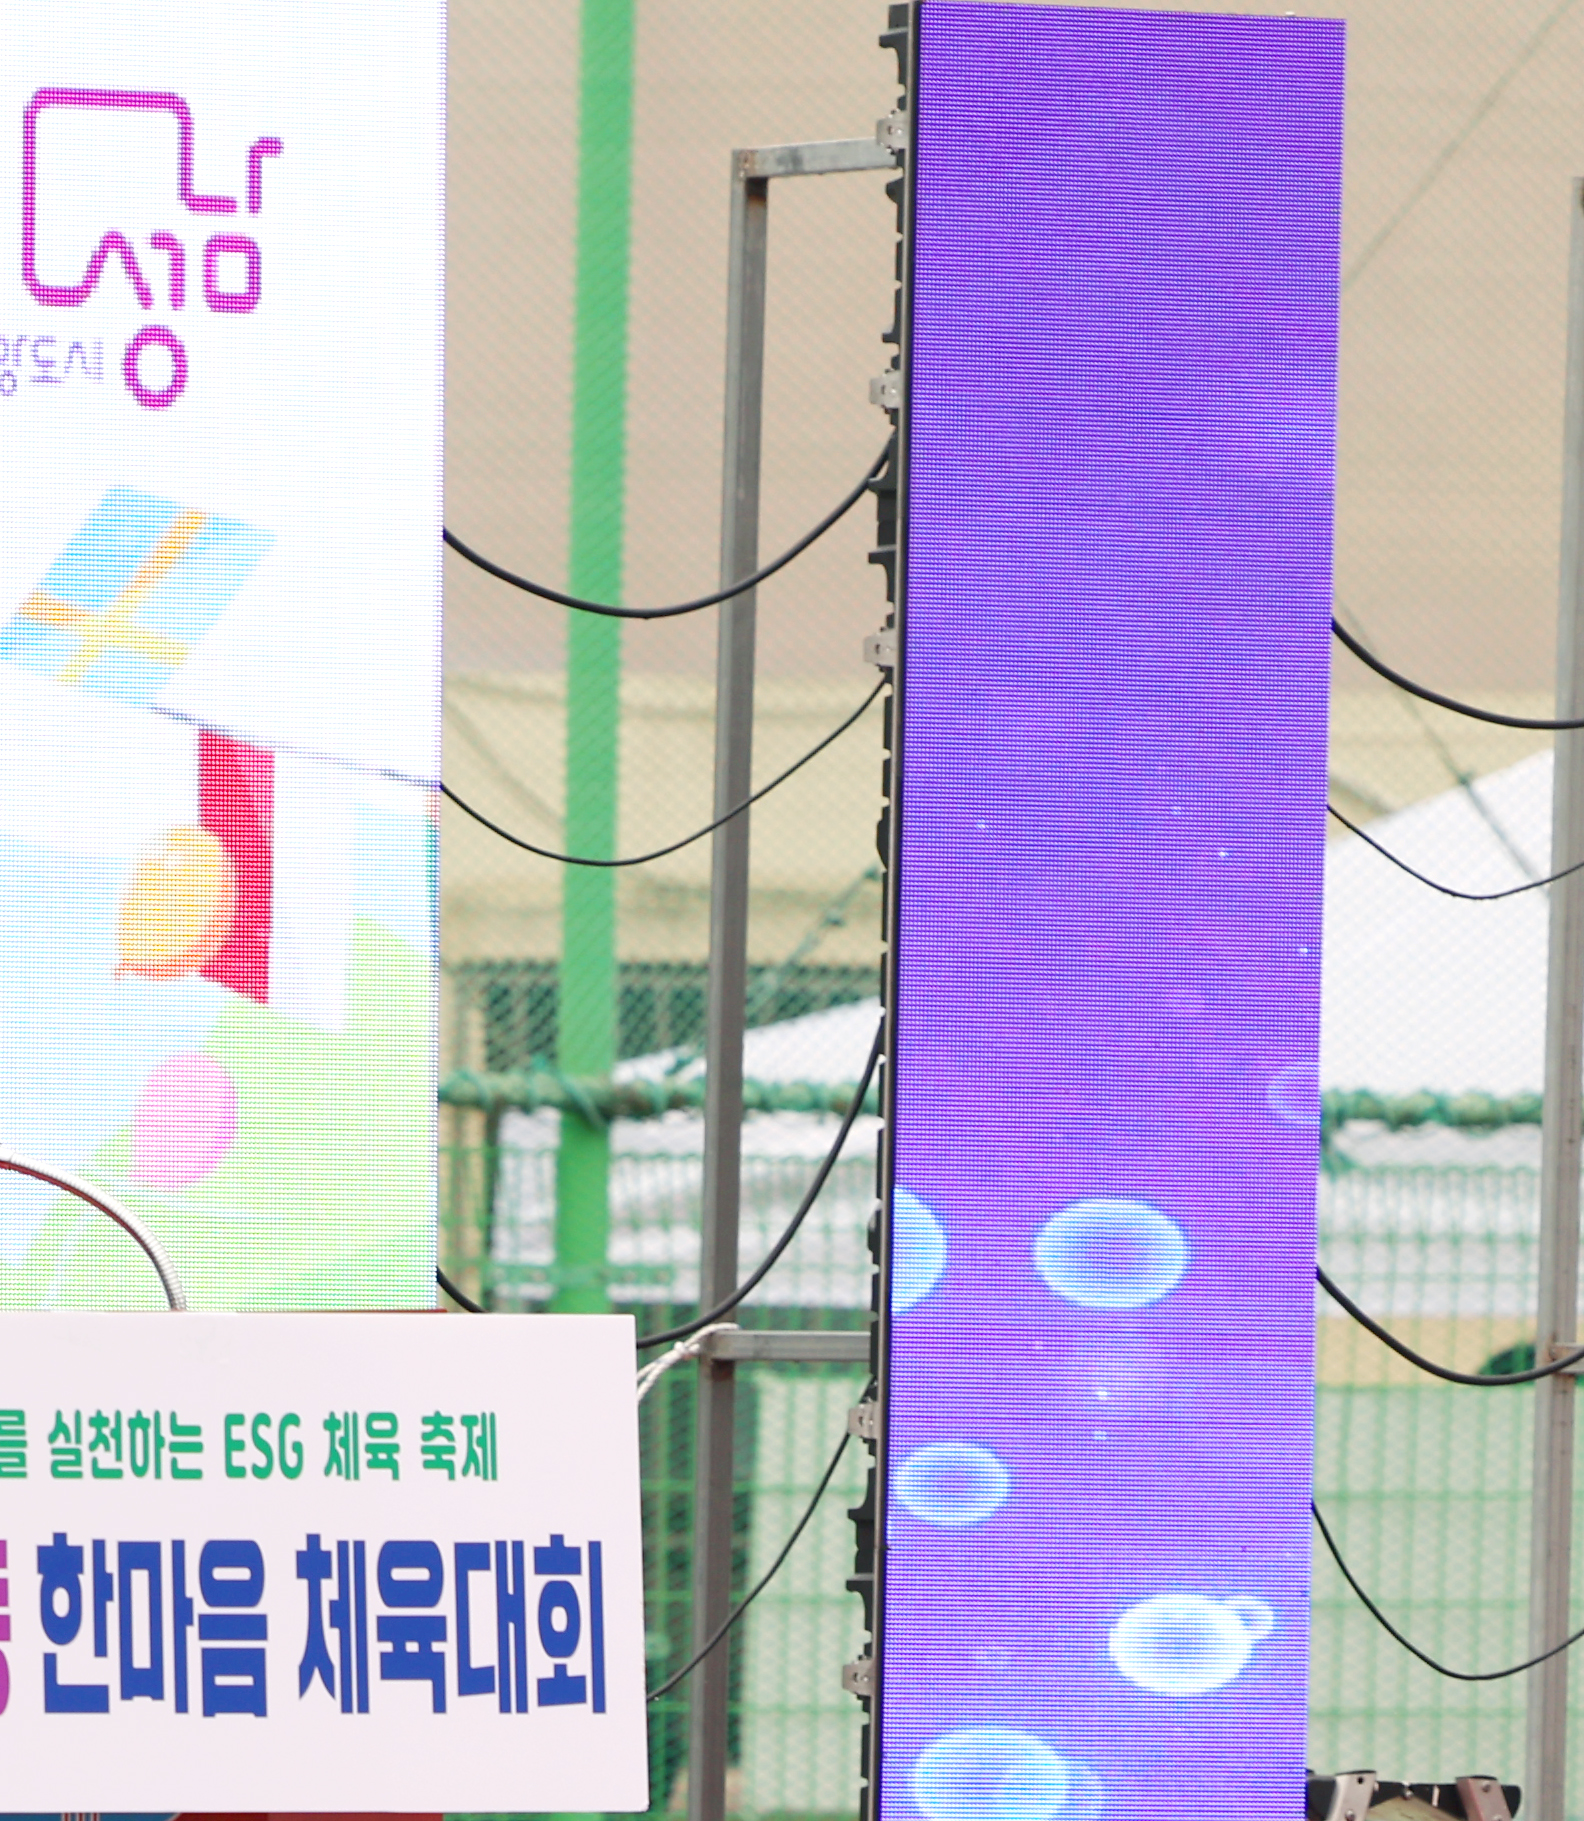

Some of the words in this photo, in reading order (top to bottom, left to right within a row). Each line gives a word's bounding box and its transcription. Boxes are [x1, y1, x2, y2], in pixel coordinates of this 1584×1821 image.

[47, 1410, 205, 1481] 실천하는
[223, 1411, 306, 1481] ESG
[322, 1410, 401, 1481] 체육
[420, 1411, 499, 1482] 축제
[36, 1531, 269, 1718] 한마음
[294, 1532, 607, 1716] 체육대회
